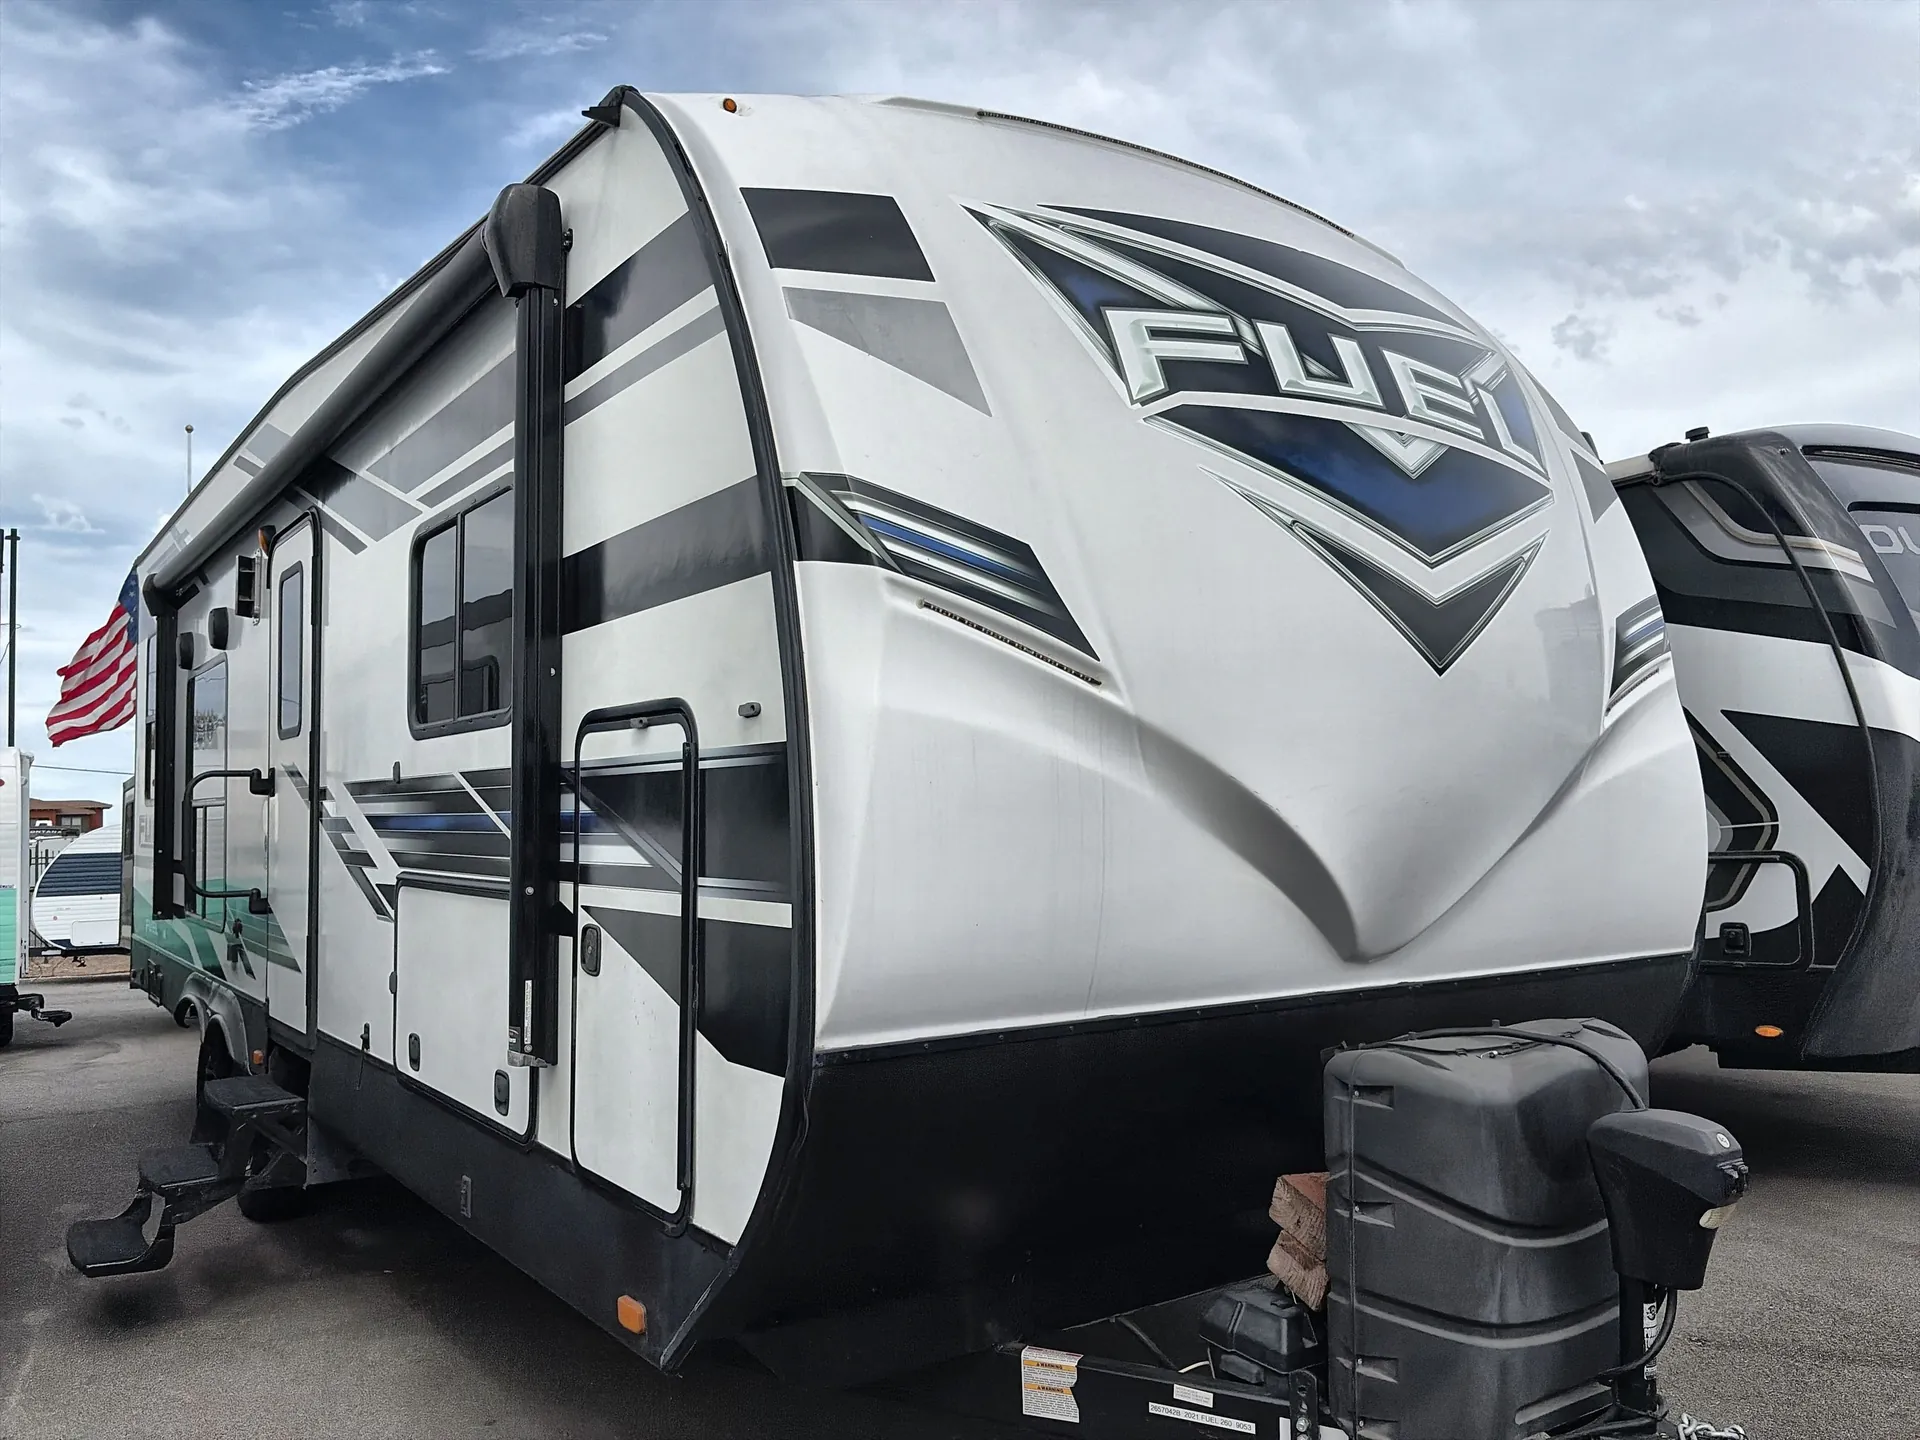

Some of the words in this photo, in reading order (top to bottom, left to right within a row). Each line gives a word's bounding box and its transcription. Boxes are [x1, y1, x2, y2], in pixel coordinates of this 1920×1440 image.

[1103, 307, 1548, 481] FUEL
[1040, 1362, 1063, 1370] WARNING
[1041, 1385, 1064, 1393] WARNING
[1184, 1411, 1199, 1420] 2021
[1201, 1415, 1219, 1425] FUEL
[1220, 1418, 1233, 1427] 260
[1235, 1422, 1252, 1431] 9053
